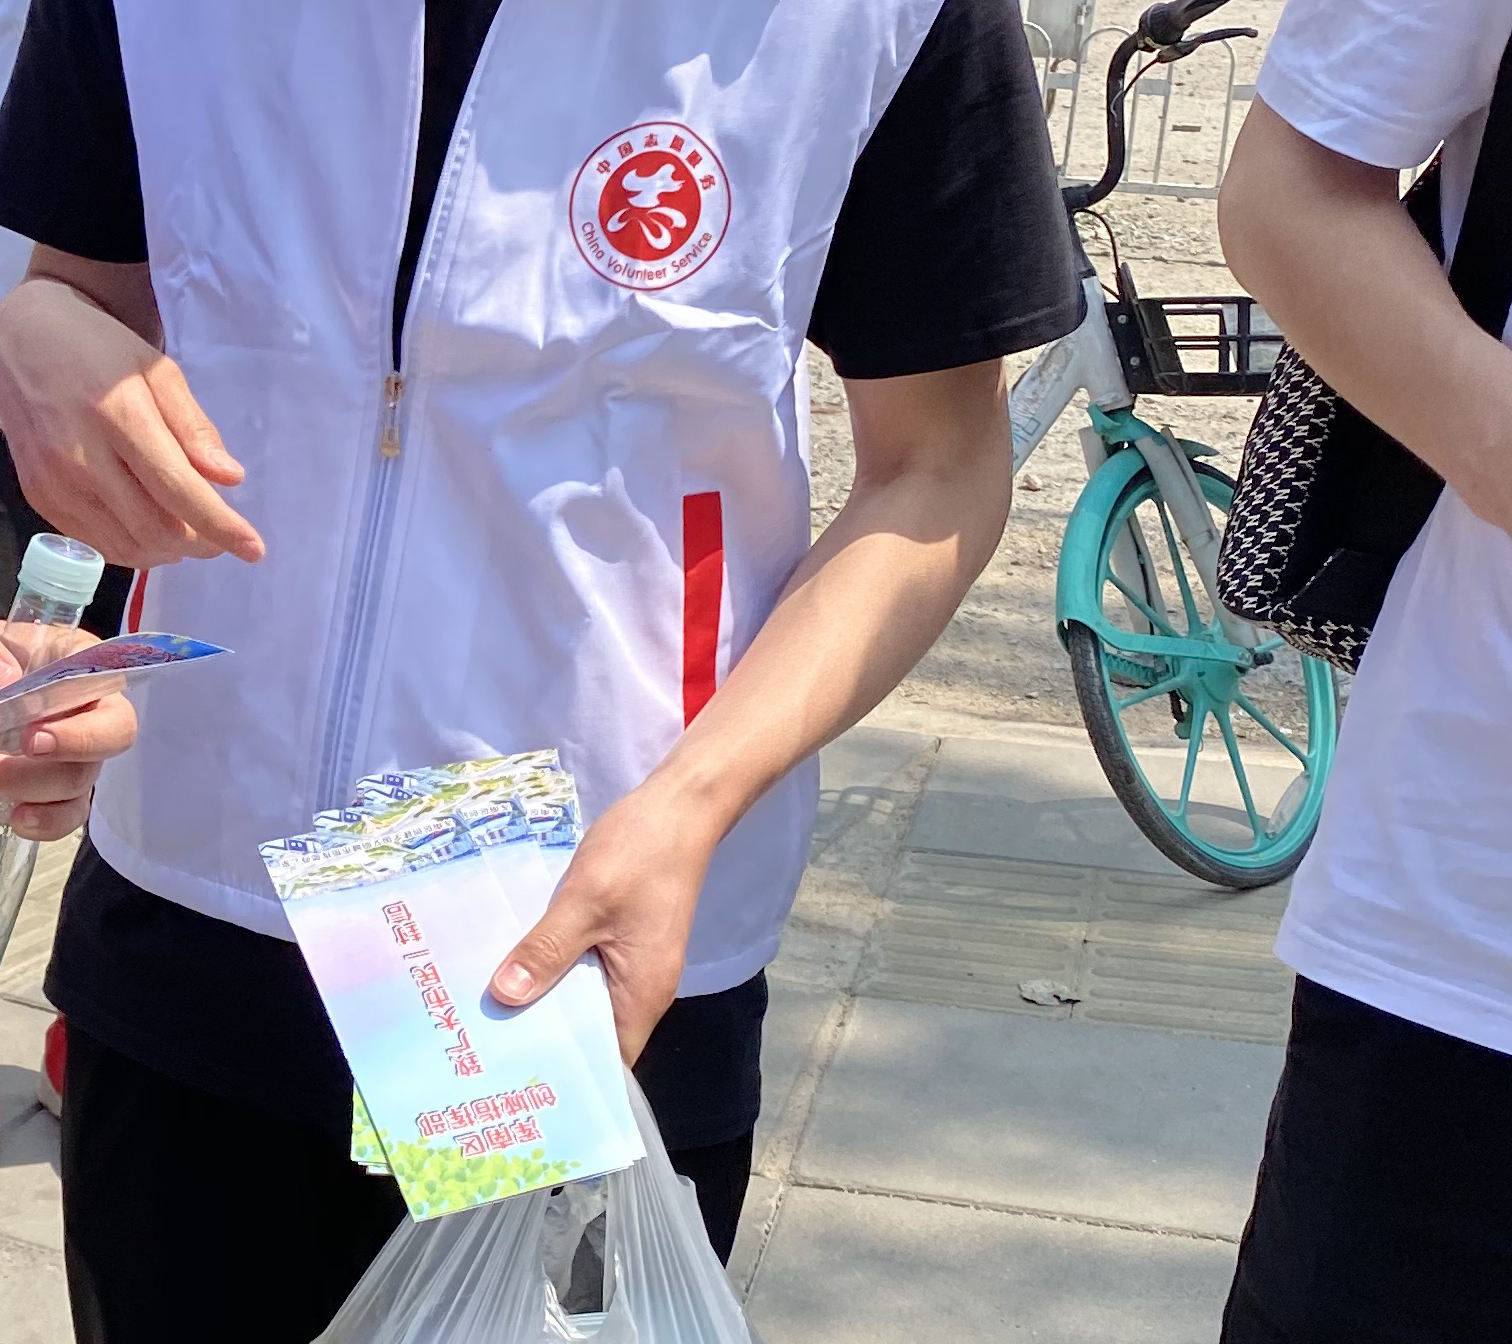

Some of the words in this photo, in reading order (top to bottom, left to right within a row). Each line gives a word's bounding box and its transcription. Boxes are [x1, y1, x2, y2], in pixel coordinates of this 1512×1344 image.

[595, 132, 716, 191] 中国志愿服务
[607, 255, 667, 281] Volunteer
[671, 232, 713, 273] Service
[381, 899, 485, 1077] 致广大市民一封信
[414, 1082, 558, 1138] 创城指挥部
[453, 1116, 543, 1159] 浑南区
